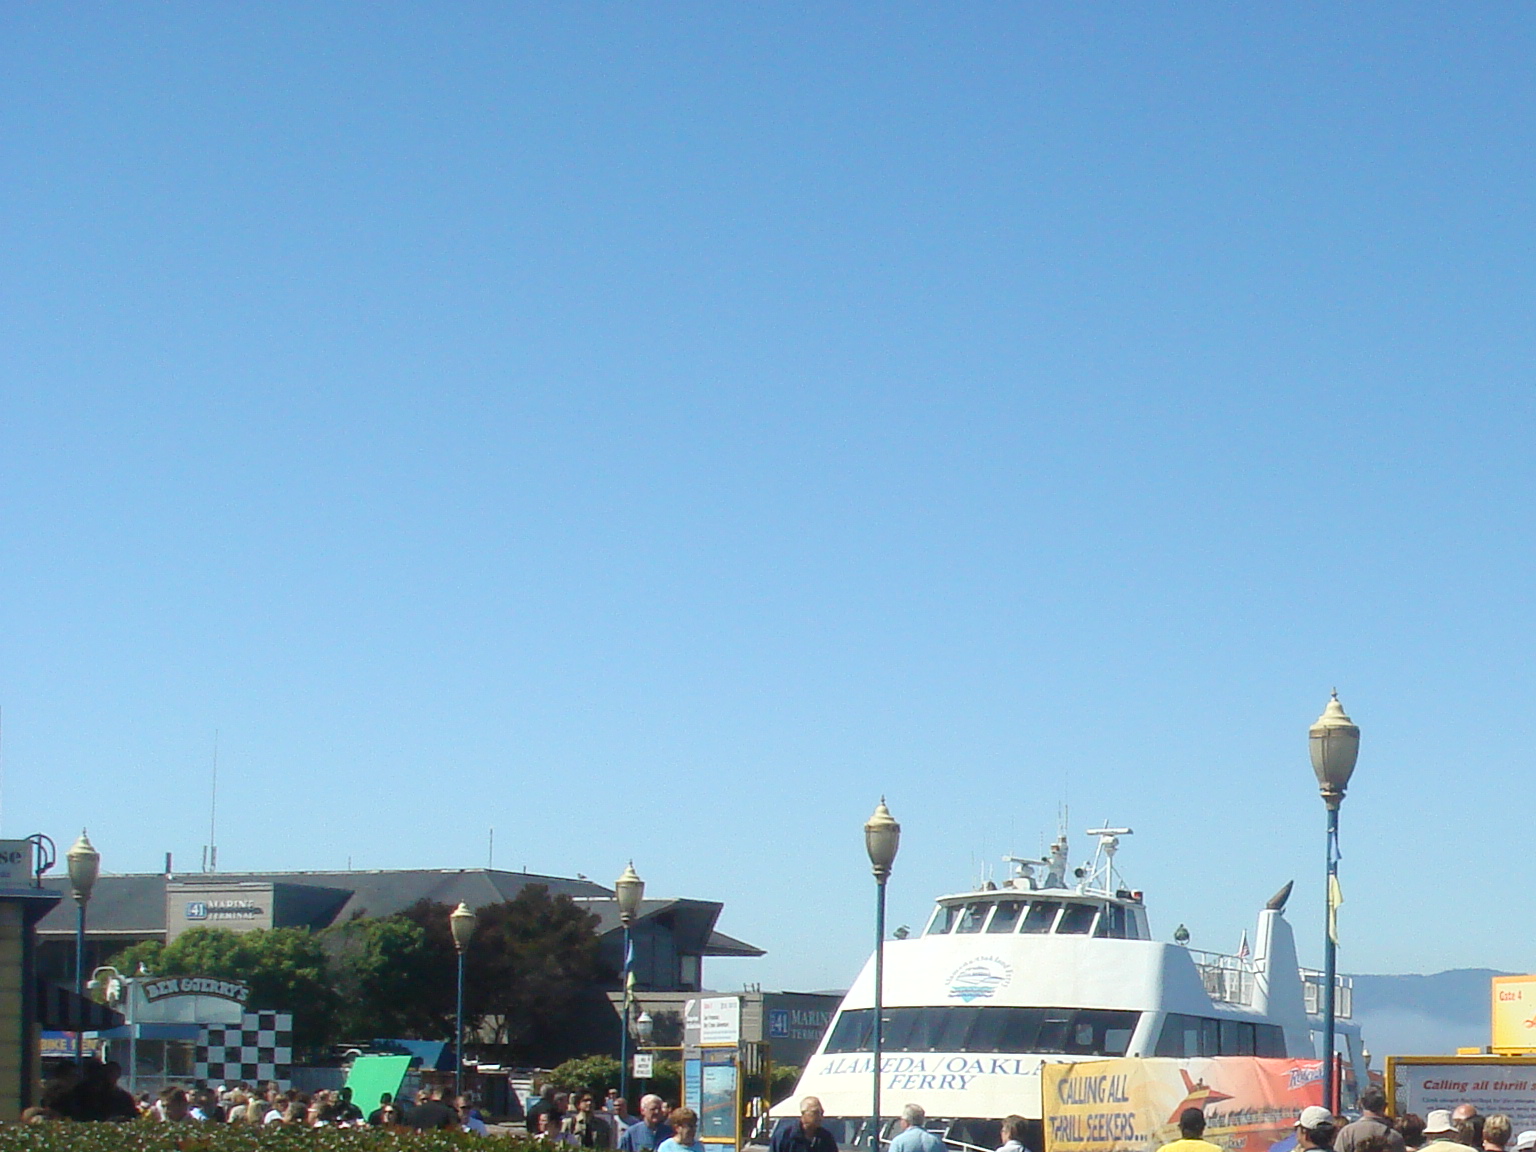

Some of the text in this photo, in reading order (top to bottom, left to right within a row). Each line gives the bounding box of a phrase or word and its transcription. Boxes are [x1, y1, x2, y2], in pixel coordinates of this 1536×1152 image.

[190, 904, 204, 917] 41
[146, 979, 179, 998] BEN
[886, 1074, 977, 1091] FERRY
[1057, 1074, 1130, 1105] CALLING ALL
[1422, 1079, 1469, 1093] Calling
[1472, 1079, 1490, 1091] all
[1492, 1079, 1528, 1091] thrill
[1049, 1114, 1084, 1142] THRILL
